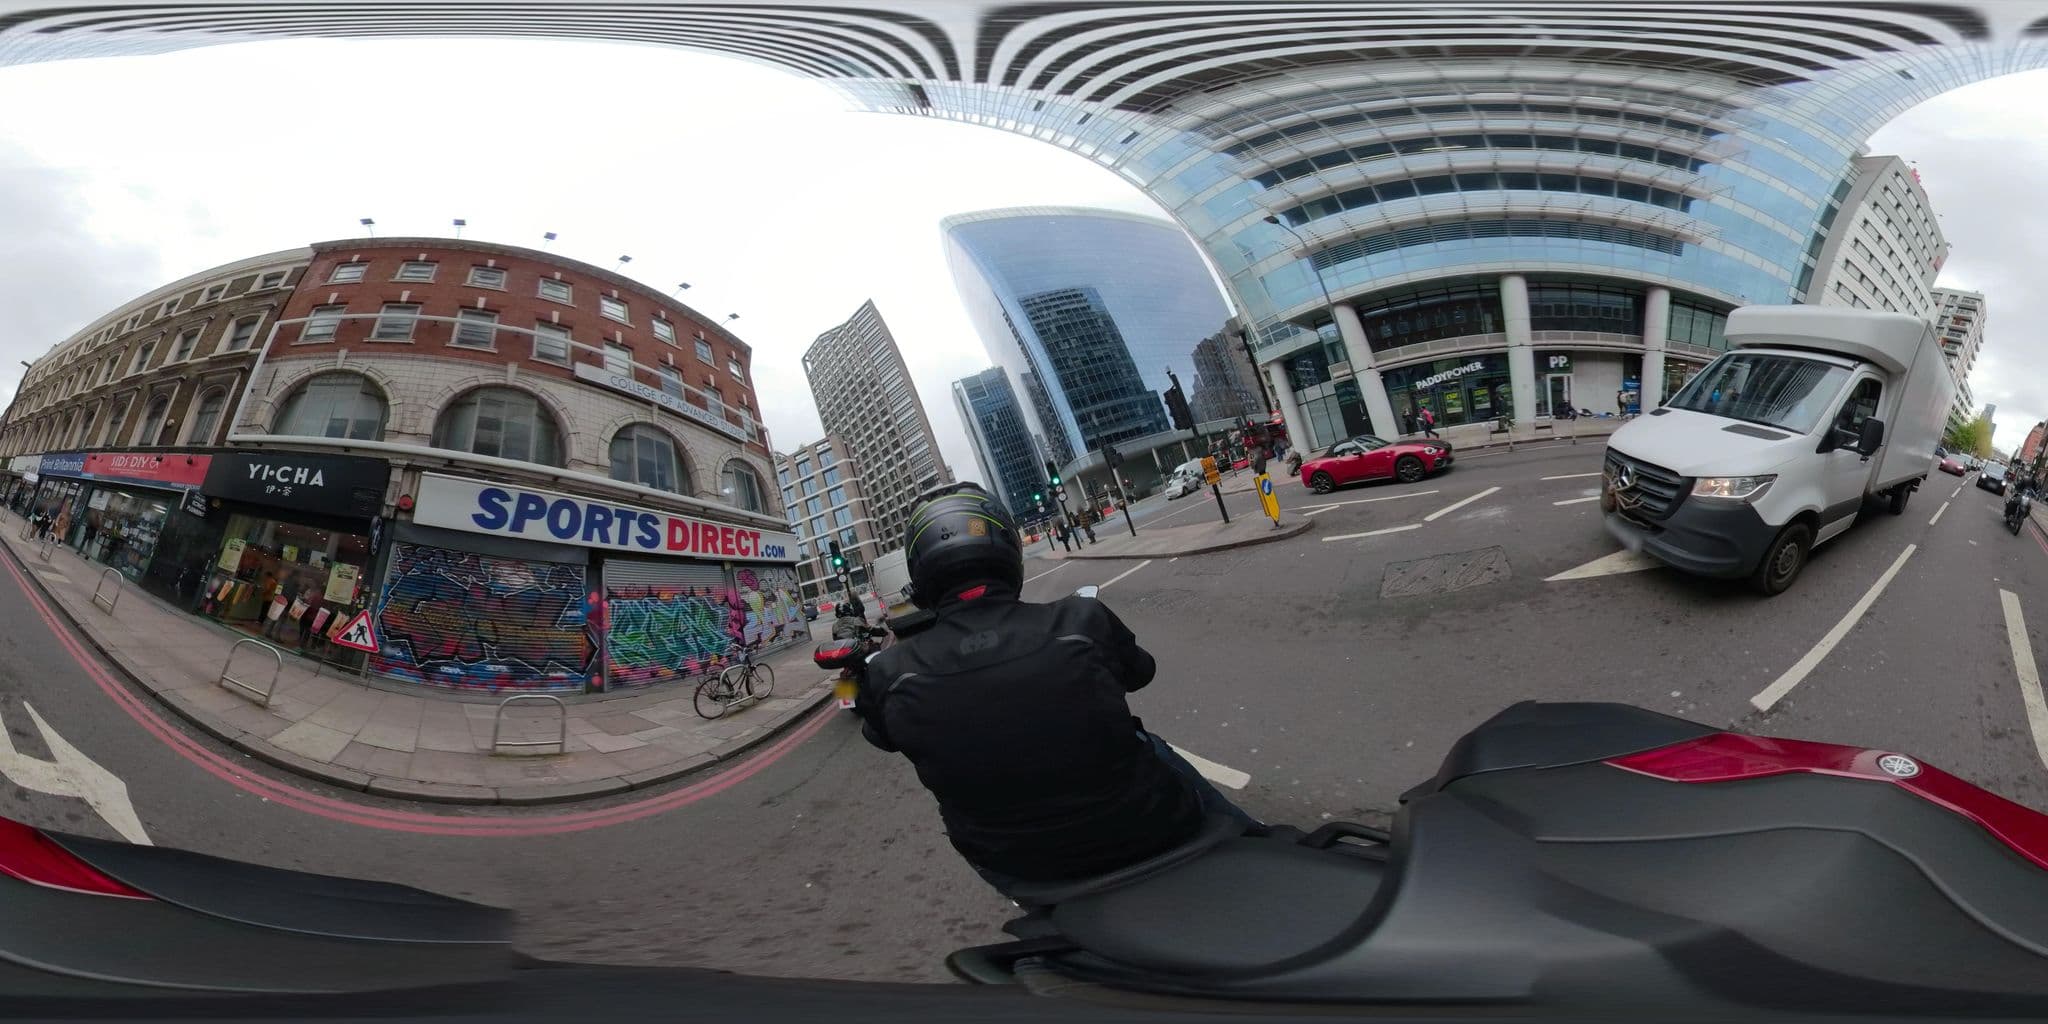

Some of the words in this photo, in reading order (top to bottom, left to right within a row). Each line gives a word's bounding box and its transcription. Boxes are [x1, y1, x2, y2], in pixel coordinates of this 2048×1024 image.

[610, 375, 656, 400] COLLEGE
[660, 393, 673, 406] OF
[677, 400, 718, 427] ADVANCED
[41, 459, 53, 470] Print
[53, 458, 84, 472] Britannia
[129, 455, 149, 468] DIY
[471, 487, 661, 549] SPORTS
